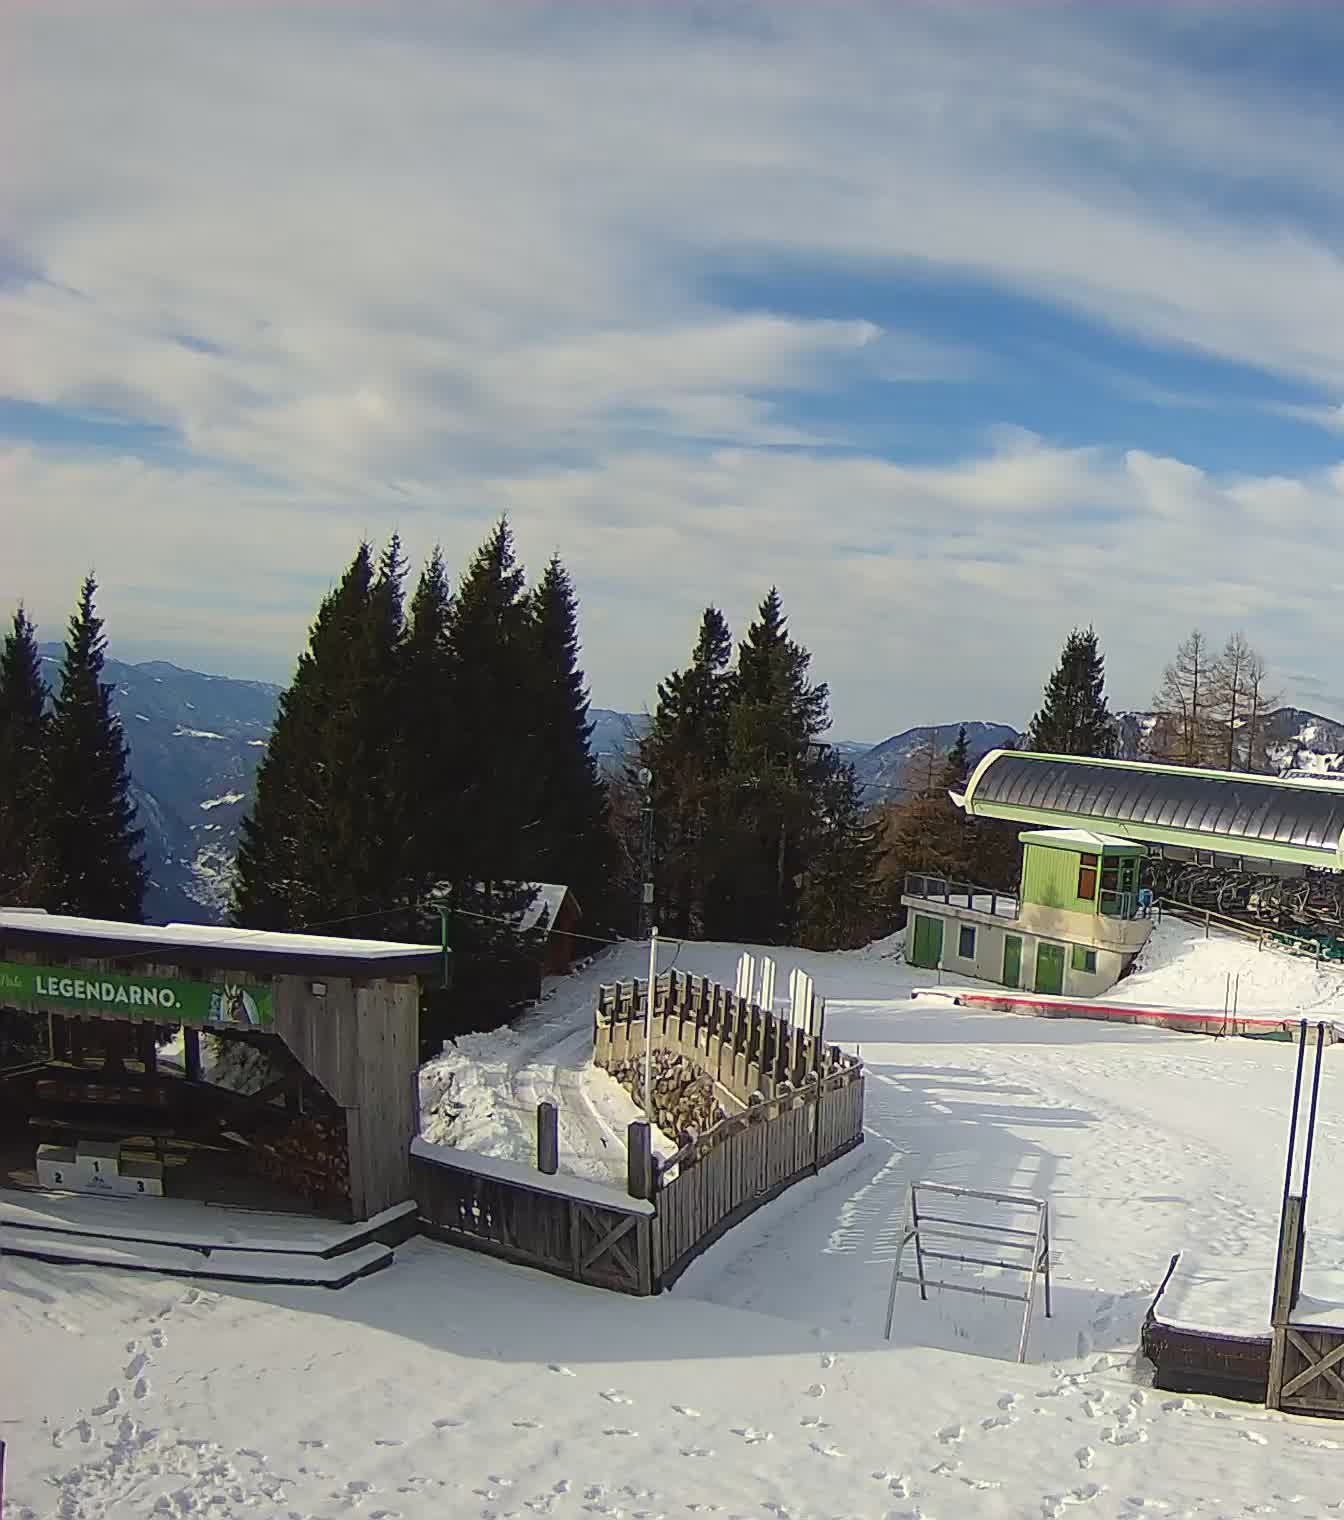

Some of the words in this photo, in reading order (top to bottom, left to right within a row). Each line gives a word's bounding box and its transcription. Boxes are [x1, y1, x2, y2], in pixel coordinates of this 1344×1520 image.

[35, 975, 182, 1009] LEGENDARNO.
[93, 1161, 100, 1173] 1
[54, 1172, 63, 1184] 2
[136, 1180, 145, 1193] 3
